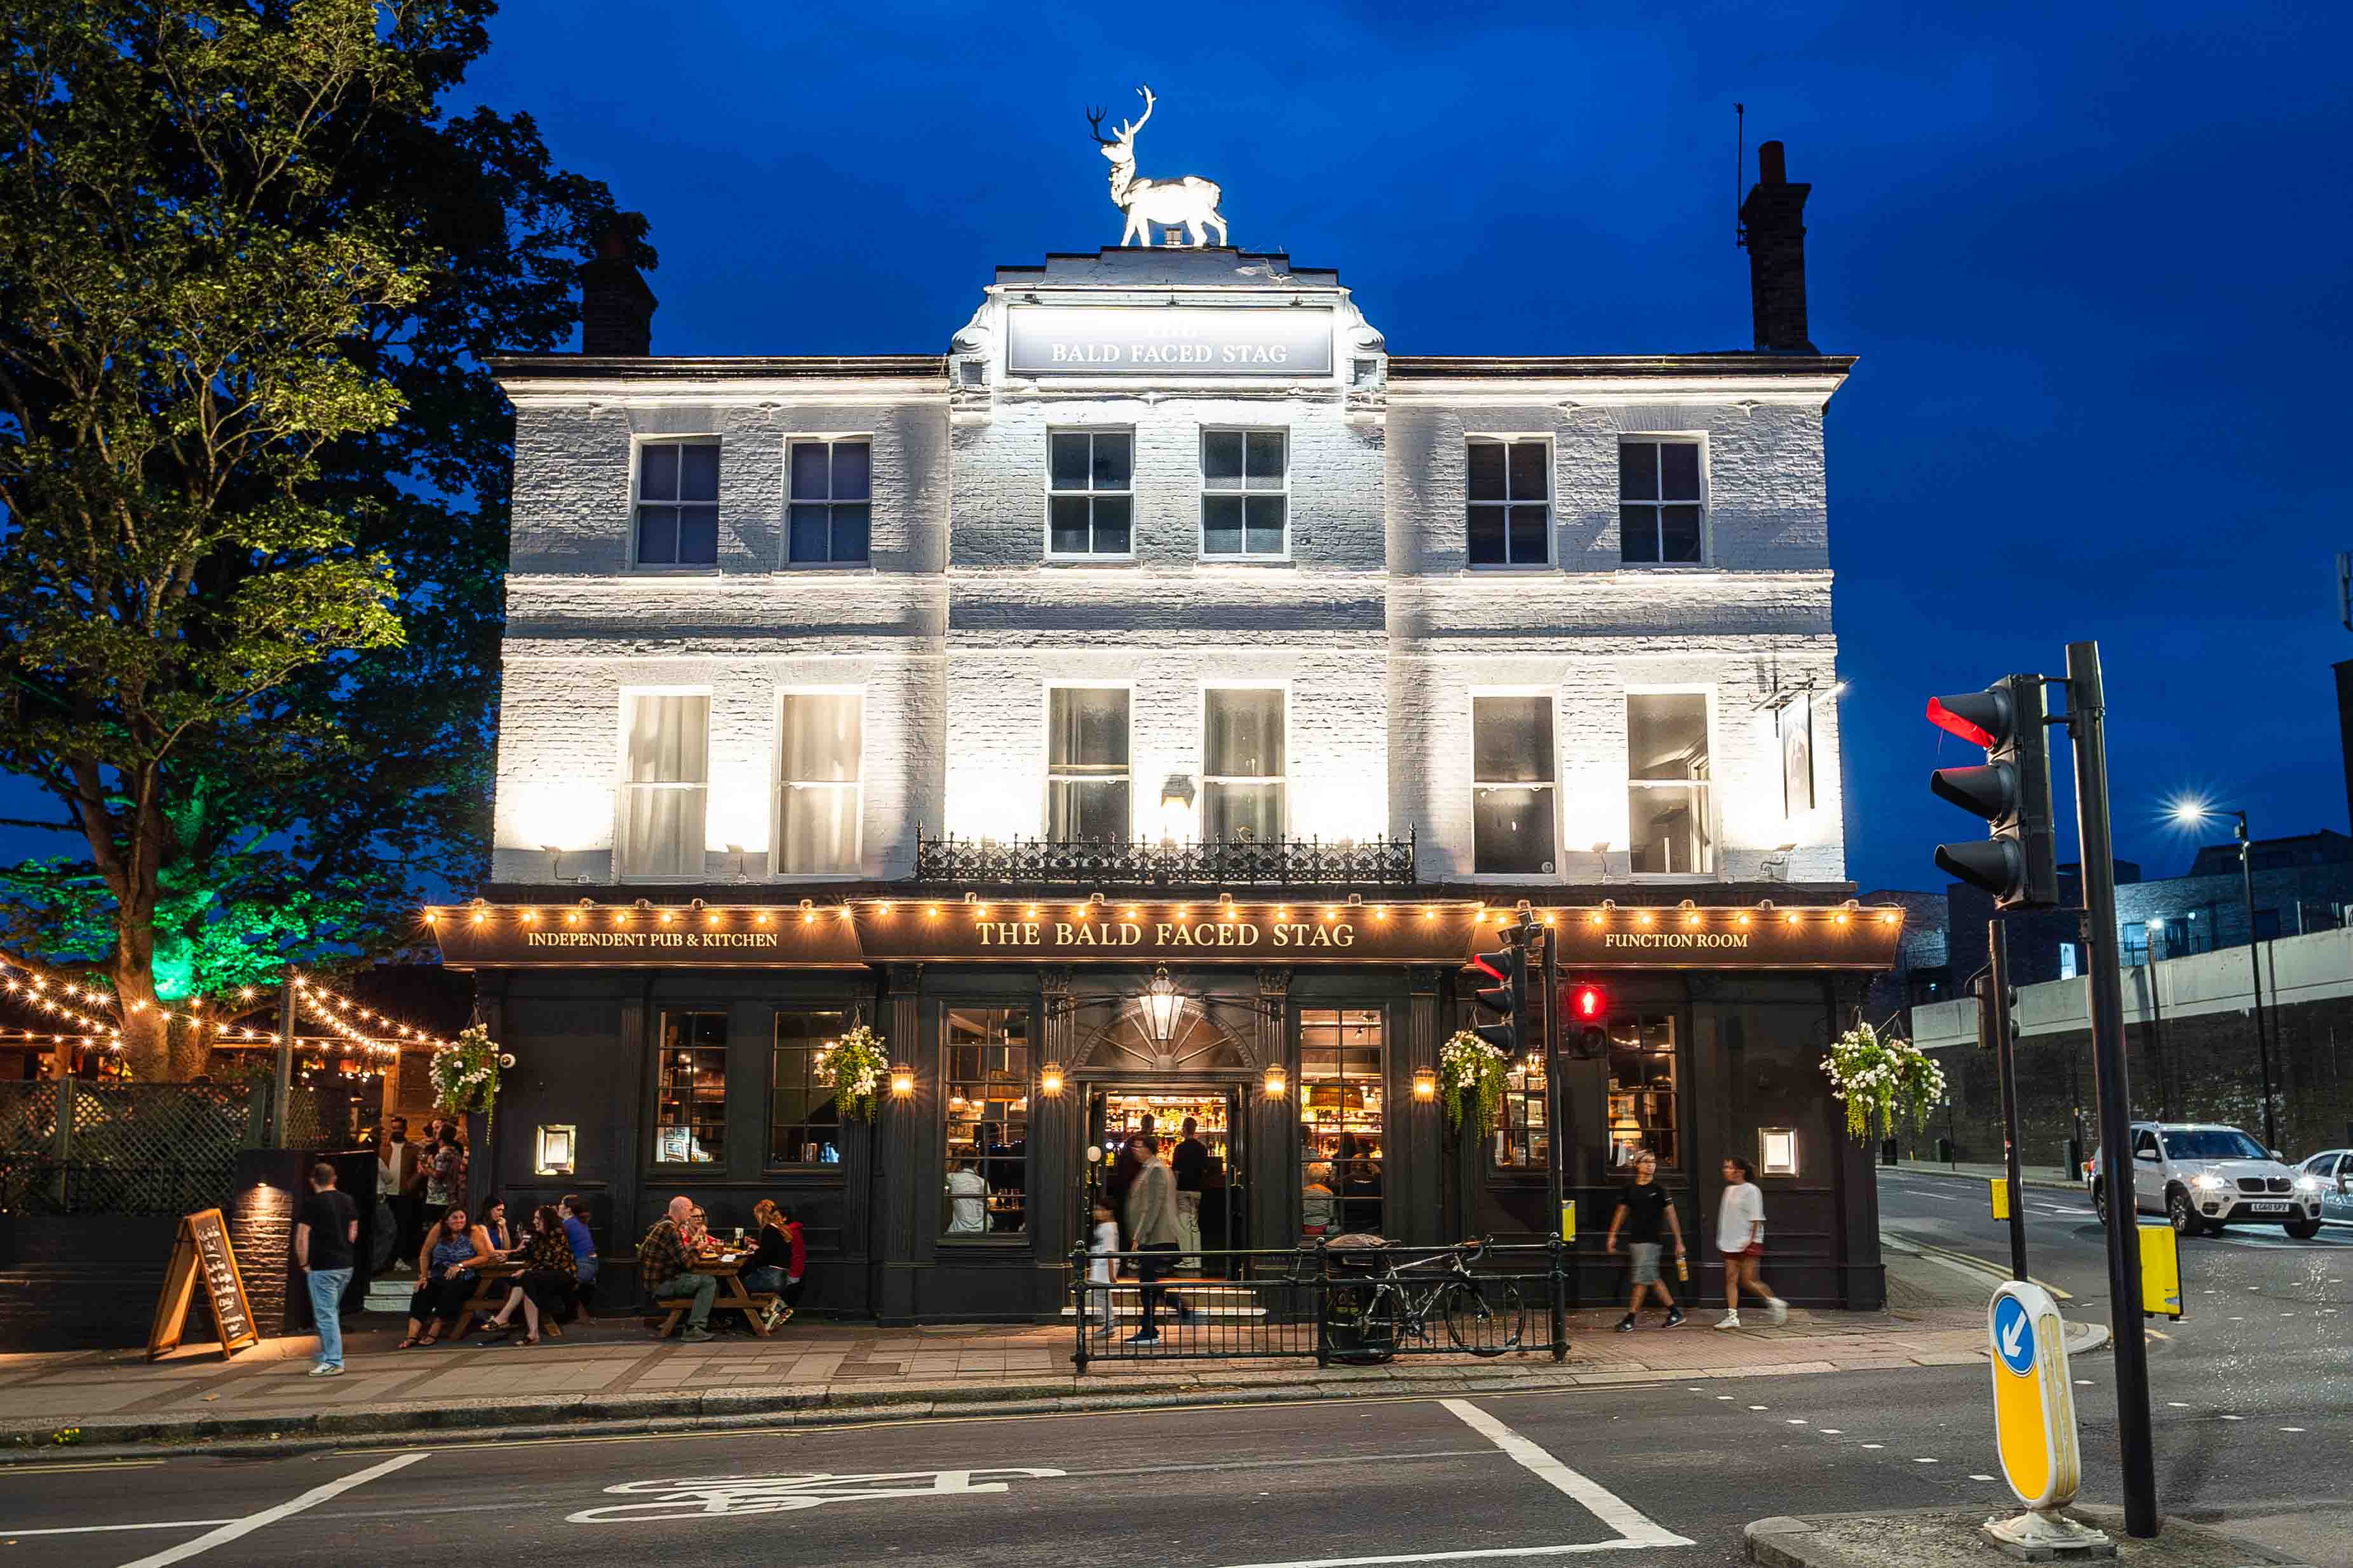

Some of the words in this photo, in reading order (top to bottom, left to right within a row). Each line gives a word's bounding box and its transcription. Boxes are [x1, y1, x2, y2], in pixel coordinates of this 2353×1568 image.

[1051, 344, 1119, 362] BALD
[1131, 345, 1213, 363] FACED
[1222, 345, 1288, 363] STAG
[528, 933, 647, 947] INDEPENDENT
[650, 934, 683, 947] PUB
[687, 934, 699, 947] &
[702, 934, 778, 947] KITCHEN
[975, 923, 1041, 945] THE
[1055, 923, 1142, 946] BALD
[1154, 923, 1260, 946] FACED
[1272, 923, 1355, 946] STAG
[1605, 934, 1694, 948] FUNCTION
[1697, 935, 1748, 948] ROOM
